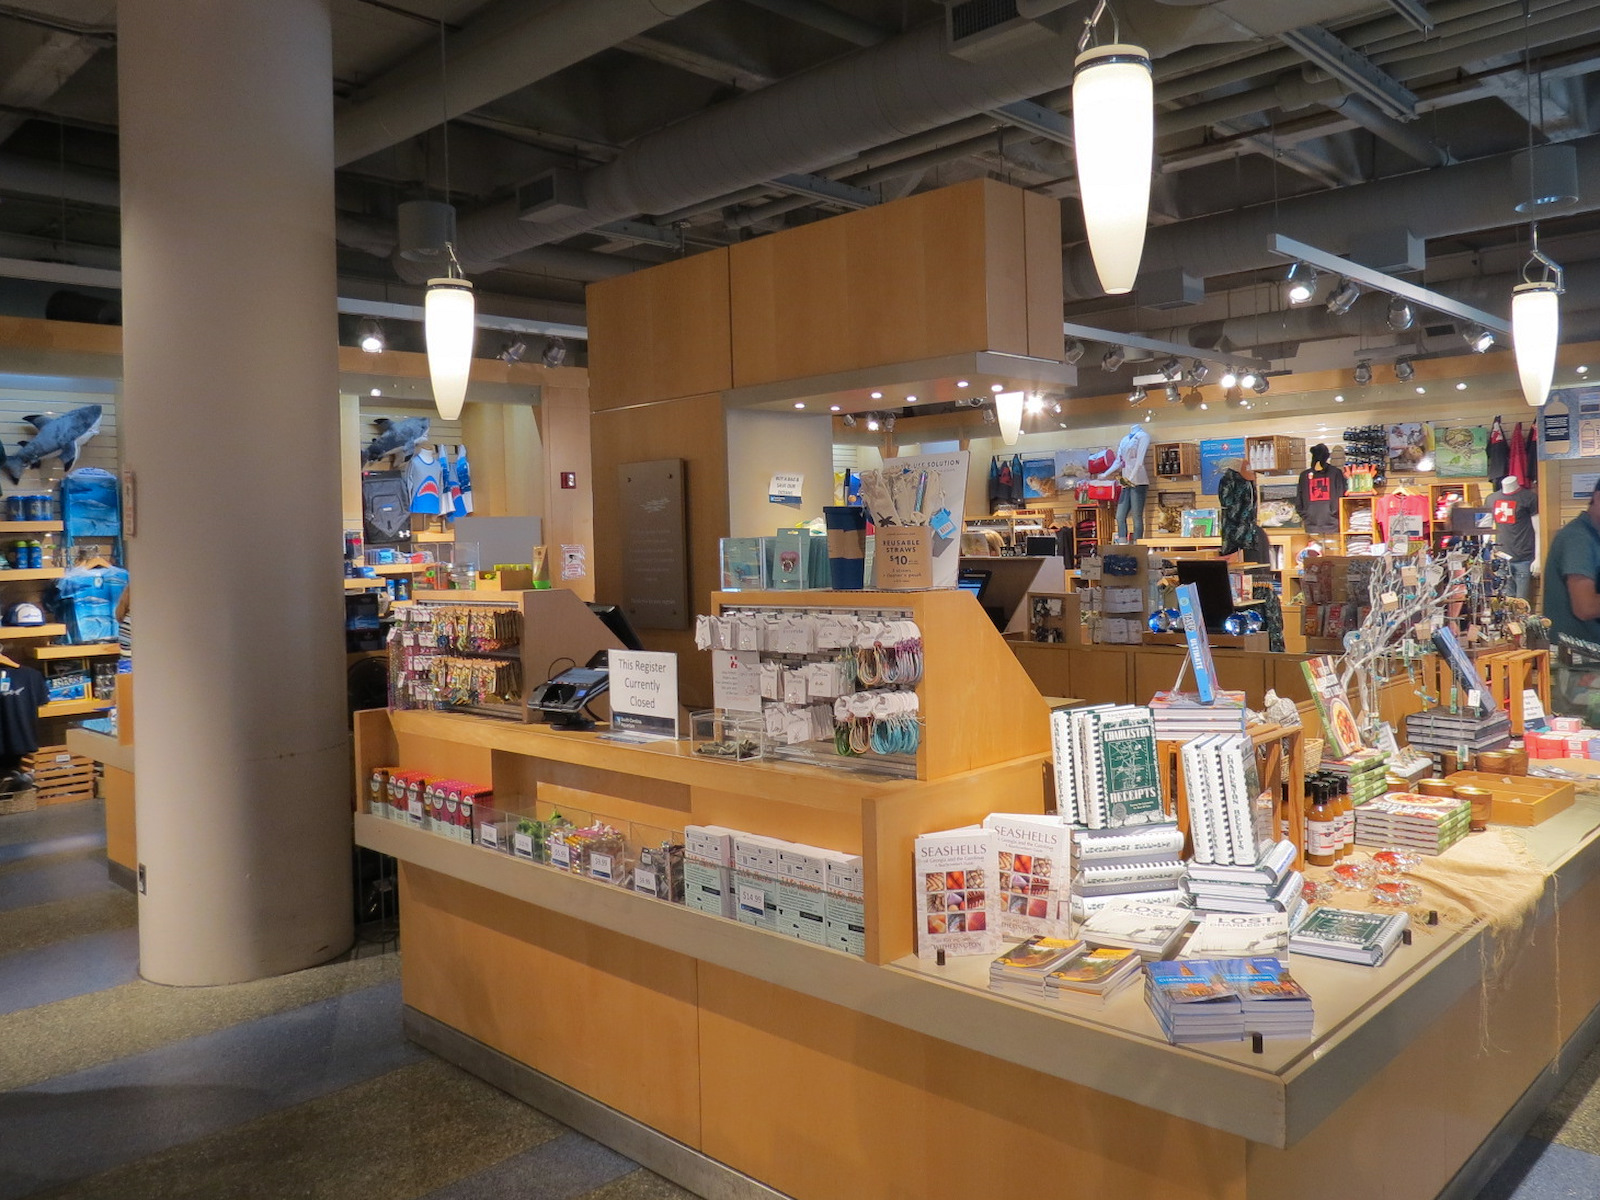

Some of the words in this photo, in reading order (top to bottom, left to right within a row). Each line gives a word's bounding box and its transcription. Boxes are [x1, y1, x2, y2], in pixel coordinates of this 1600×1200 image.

[927, 459, 960, 468] SOLUTION
[890, 555, 908, 565] $10
[1190, 638, 1204, 670] ULTIMATE
[618, 658, 634, 671] This
[635, 660, 667, 674] Register
[624, 677, 661, 693] Currently
[629, 695, 655, 709] Closed
[1103, 726, 1150, 742] CHARLESTON
[1109, 786, 1156, 804] RECEIPTS
[994, 825, 1058, 844] SEASHELLS
[921, 844, 987, 858] SEASHELLS
[742, 891, 762, 904] $14.99
[1123, 904, 1179, 916] LOST
[1218, 916, 1276, 924] LOST
